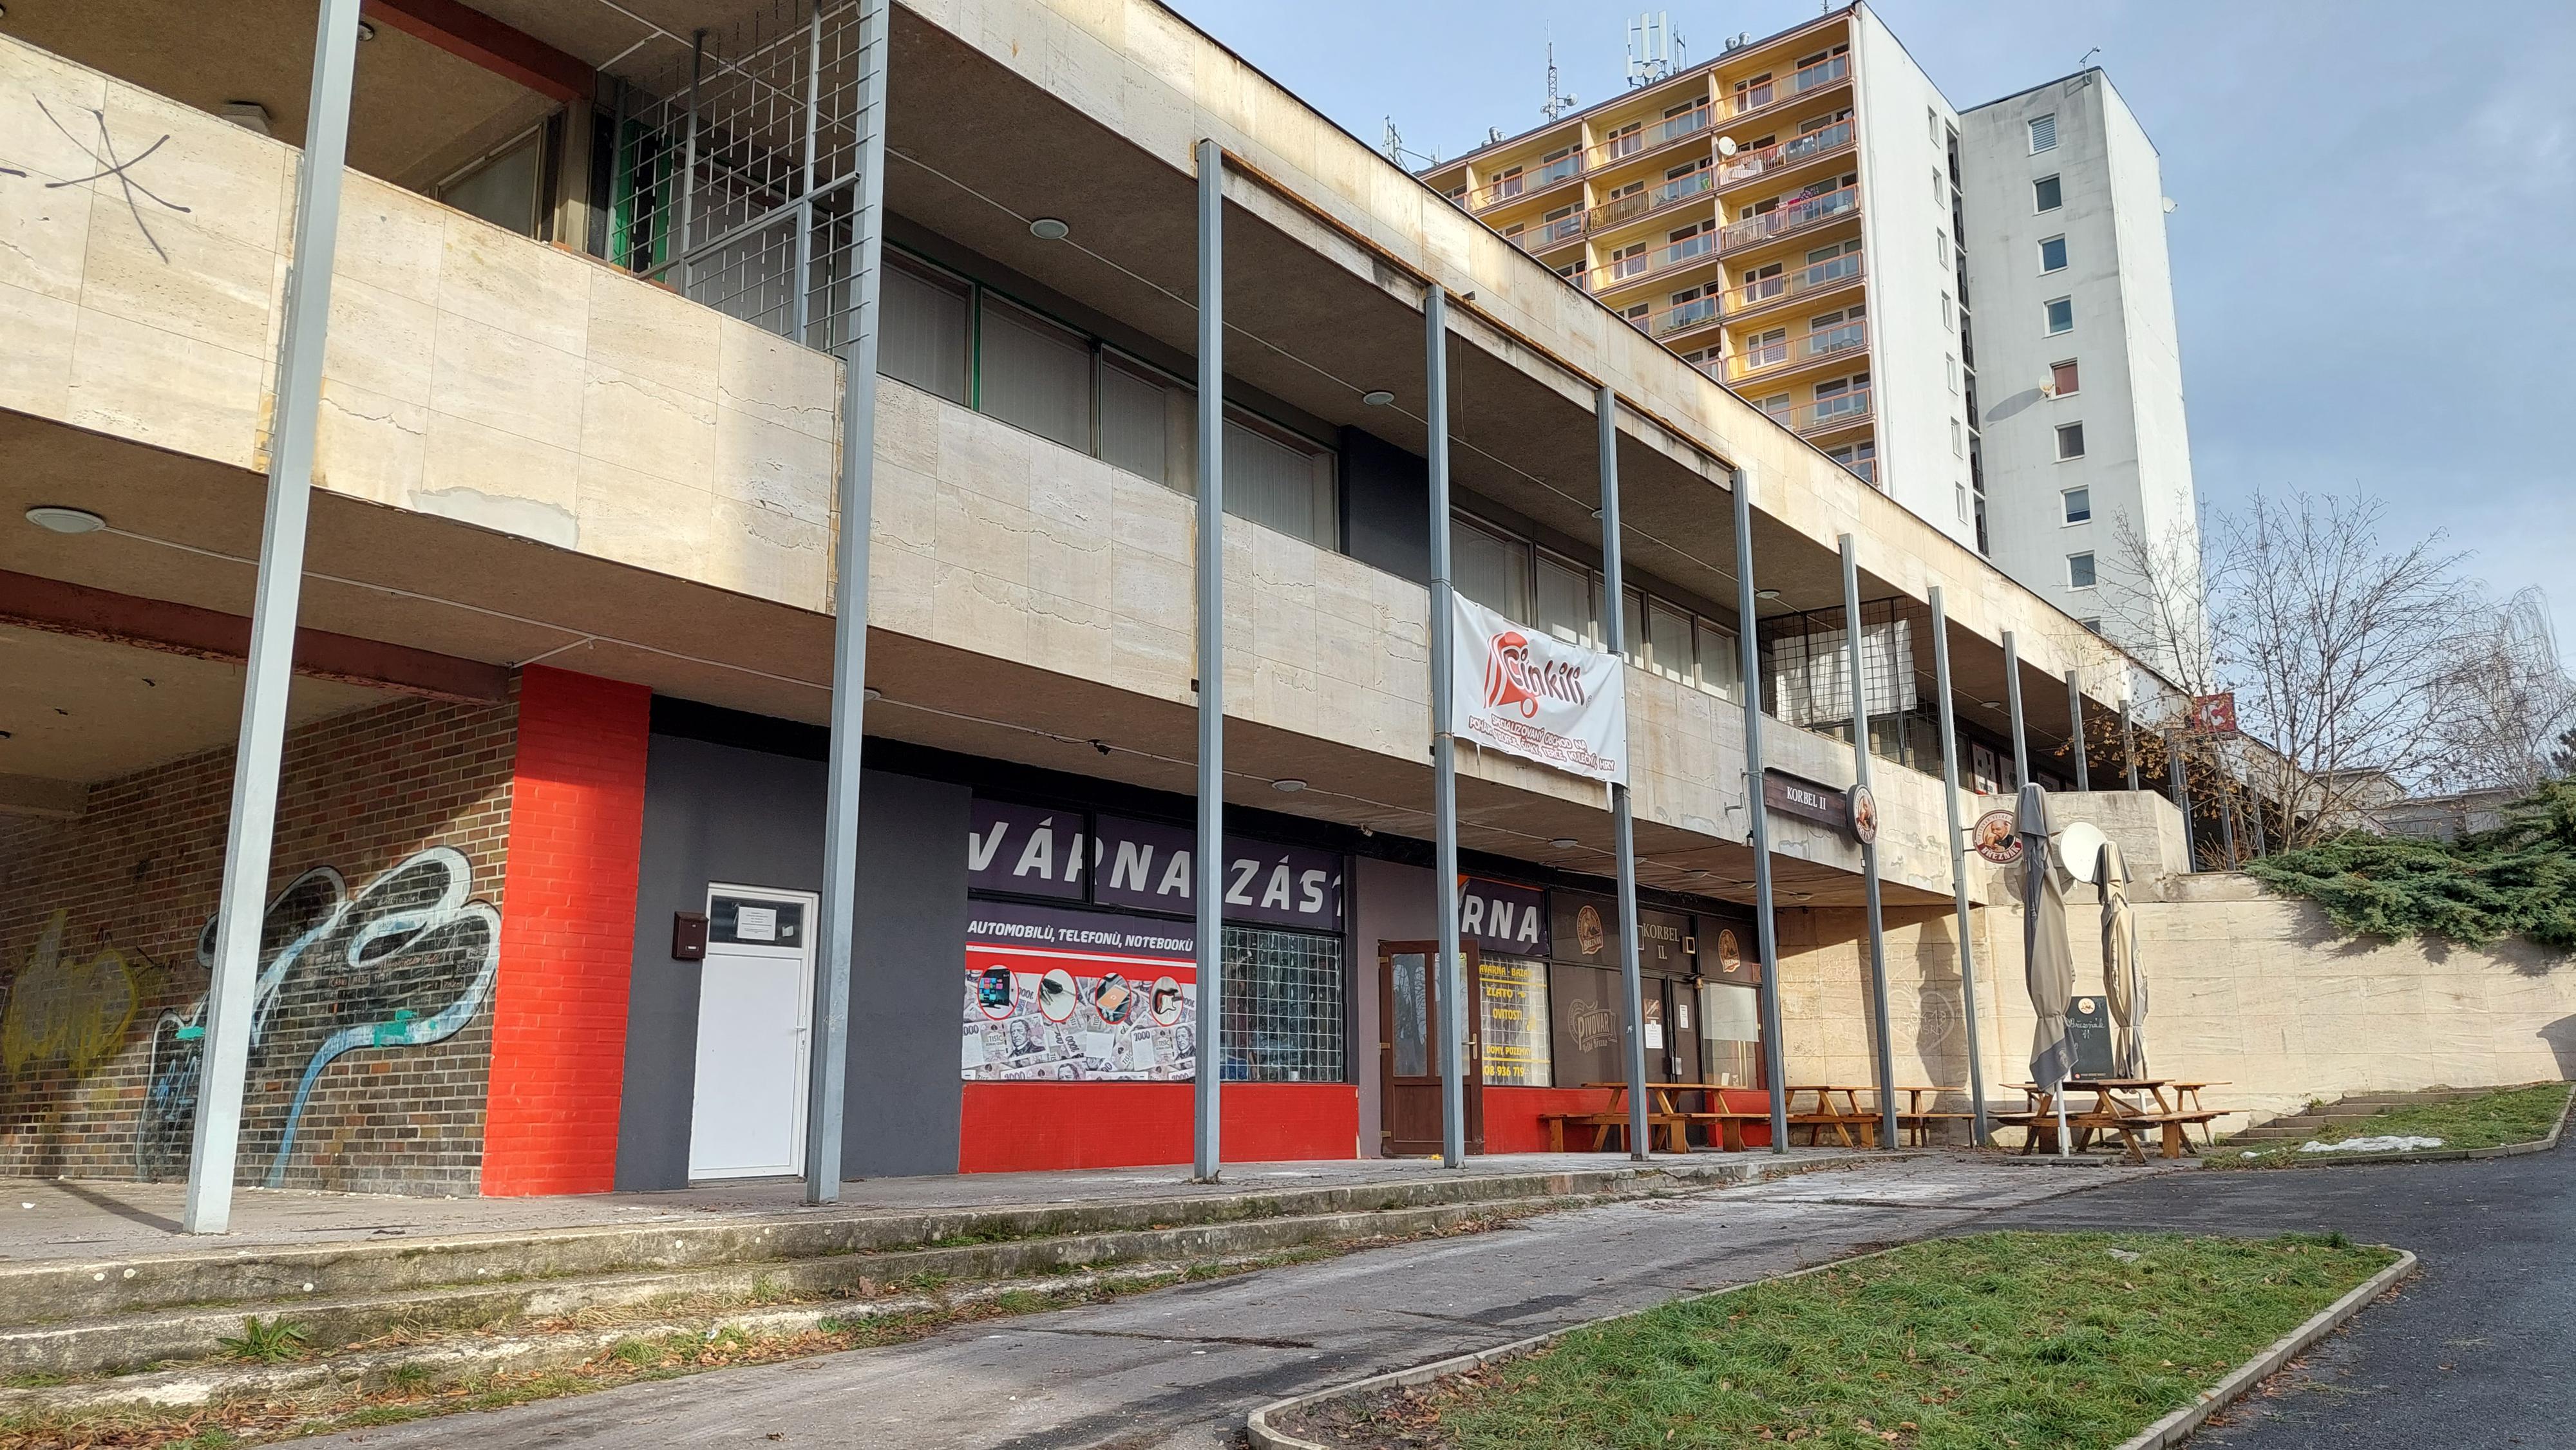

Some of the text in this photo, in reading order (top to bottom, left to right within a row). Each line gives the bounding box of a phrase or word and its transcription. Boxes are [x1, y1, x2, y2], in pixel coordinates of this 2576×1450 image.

[1544, 731, 1572, 749] OBCHOD
[1573, 739, 1587, 751] NA
[1599, 757, 1615, 771] HRY
[1786, 786, 1826, 810] KORBEL II
[1643, 923, 1680, 942] KORBEL
[1486, 987, 1513, 998] ZLATO
[1133, 1030, 1151, 1042] 1000
[1577, 1012, 1609, 1051] PIVOVAR
[1505, 1046, 1531, 1056] POZEMKY
[1497, 1066, 1511, 1077] 936
